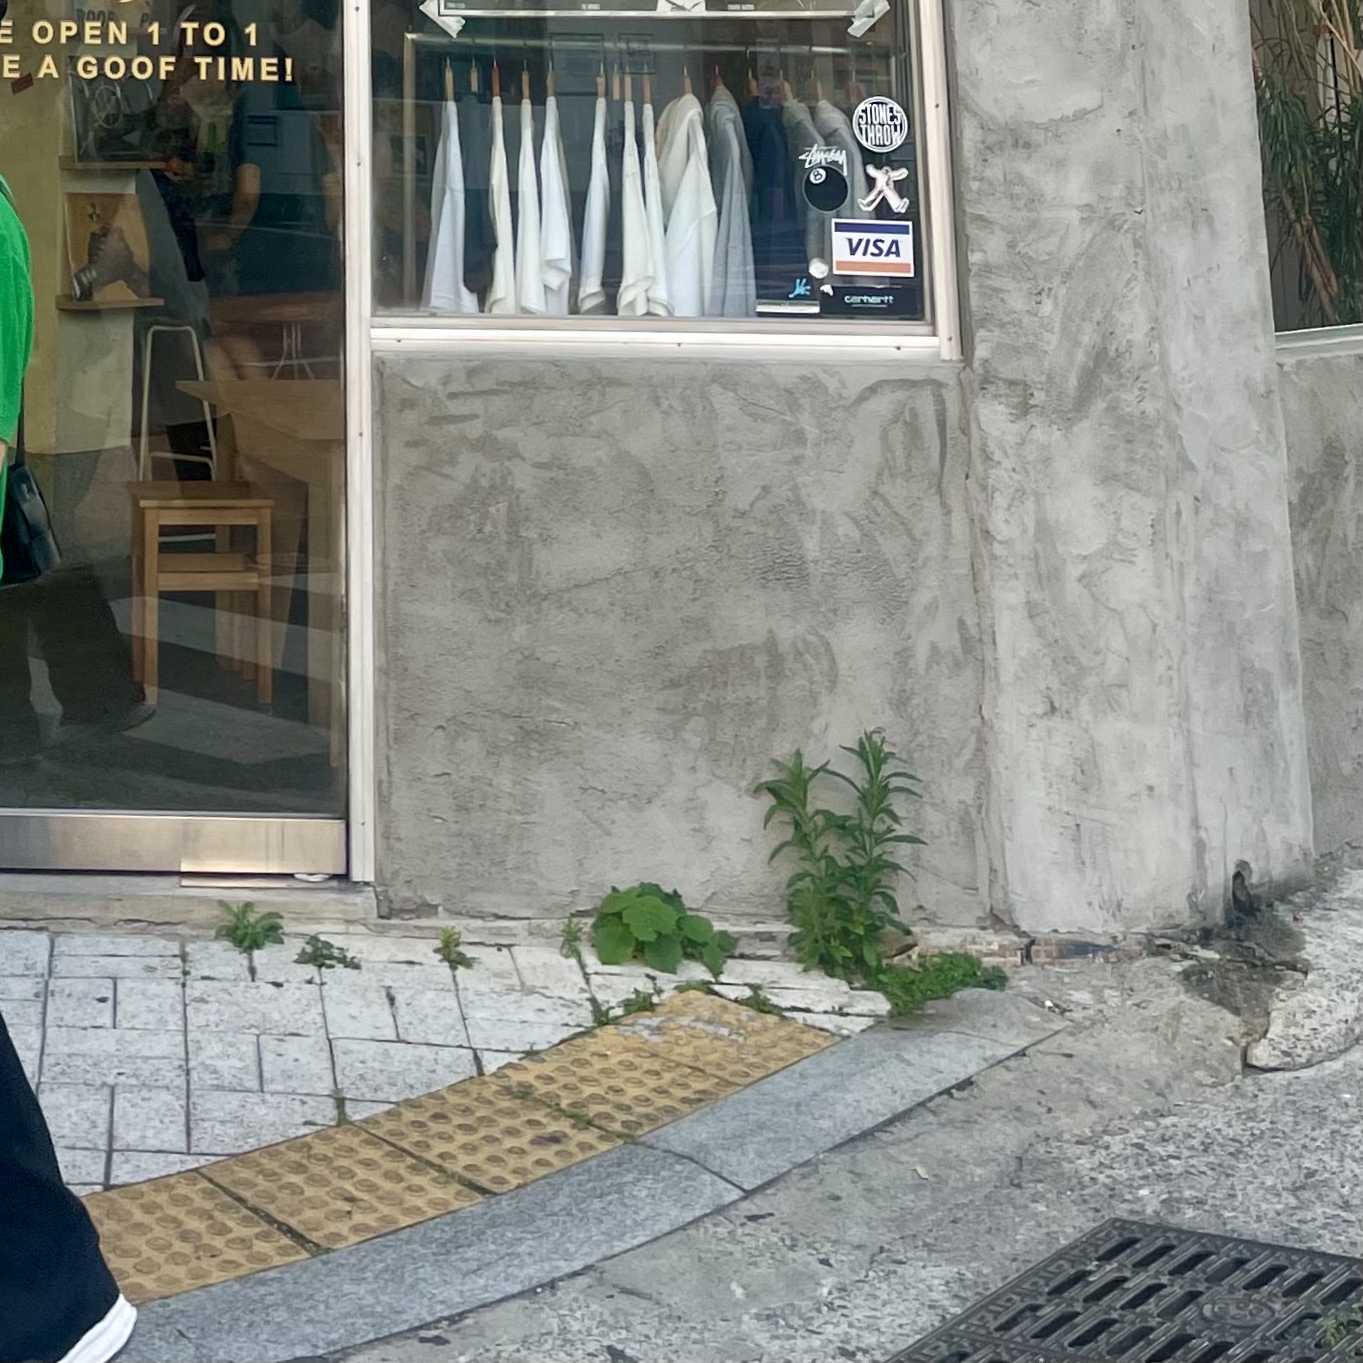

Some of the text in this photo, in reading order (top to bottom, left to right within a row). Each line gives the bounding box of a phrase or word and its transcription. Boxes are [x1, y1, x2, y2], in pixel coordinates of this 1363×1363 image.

[32, 21, 128, 45] OPEN
[147, 22, 160, 45] 1
[180, 22, 226, 47] TO
[244, 23, 257, 46] 1
[36, 53, 60, 78] A
[76, 55, 177, 80] GOOF
[193, 55, 294, 81] TIME!
[858, 103, 902, 126] STONES
[861, 122, 902, 146] THROW
[847, 238, 901, 257] VISA
[844, 295, 894, 304] carhartt
